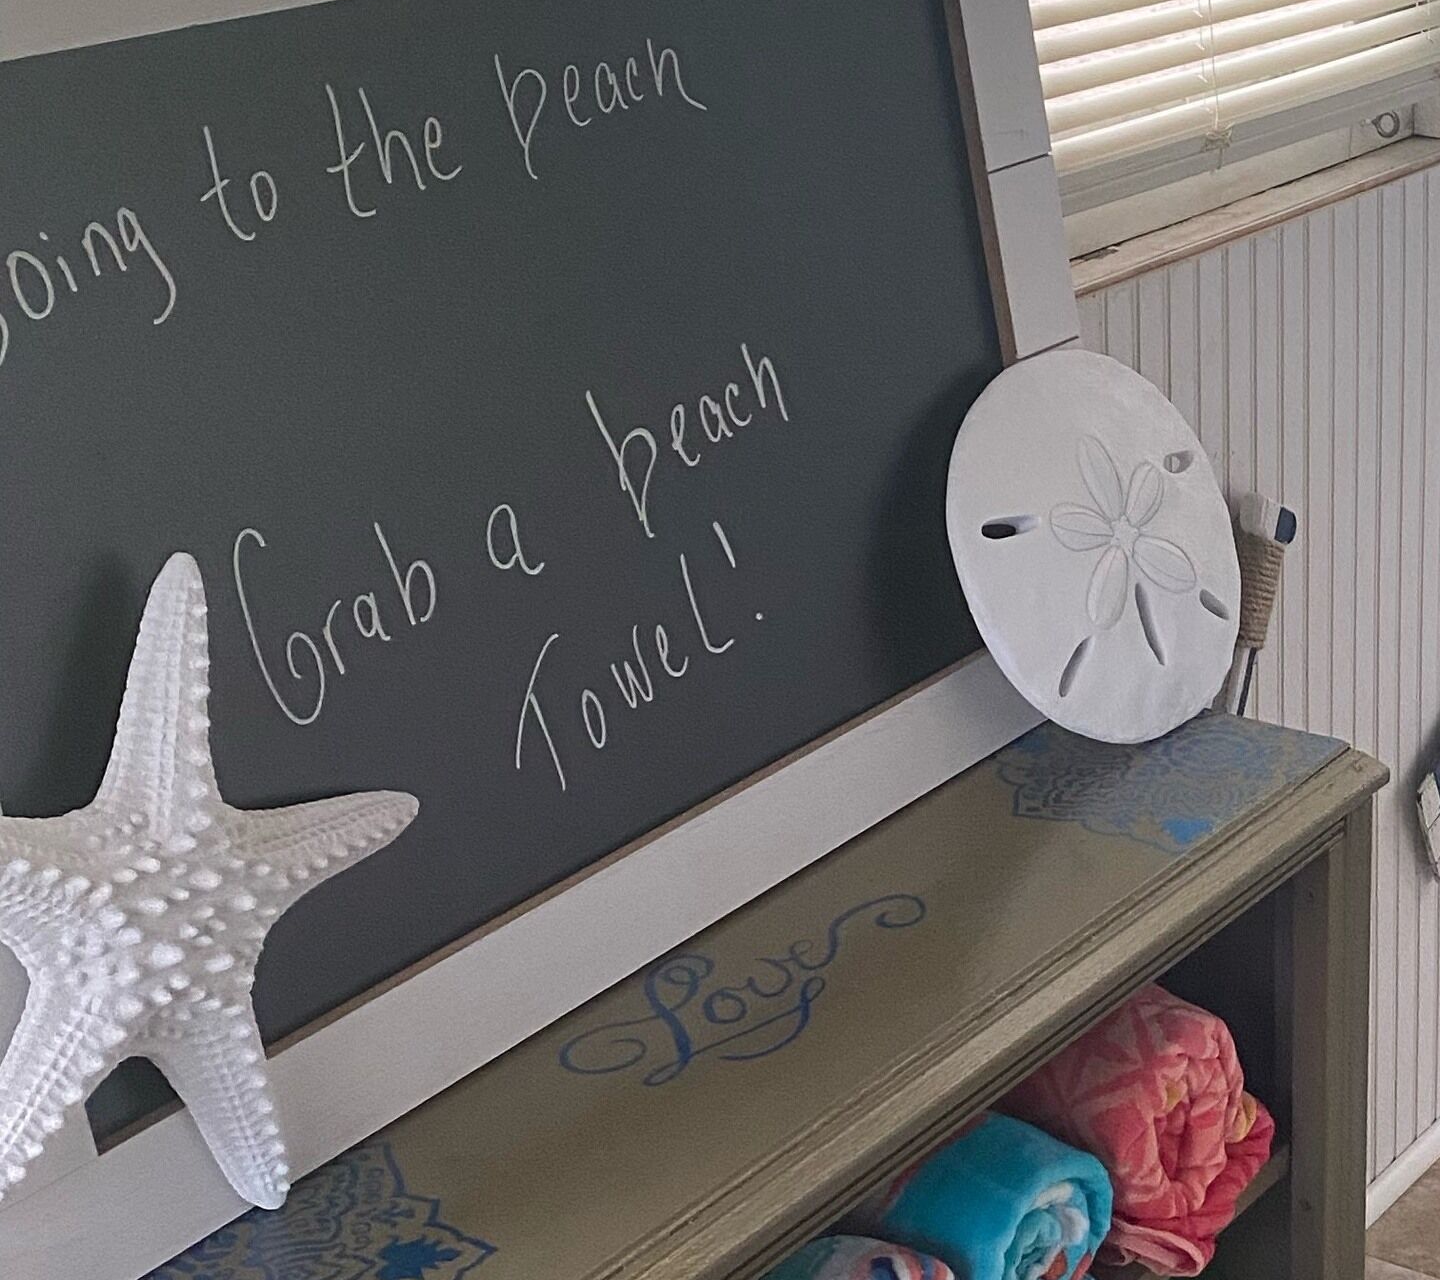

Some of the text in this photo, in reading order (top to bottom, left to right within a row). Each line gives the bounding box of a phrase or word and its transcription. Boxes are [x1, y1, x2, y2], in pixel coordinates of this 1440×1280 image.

[200, 126, 279, 241] to
[326, 84, 463, 219] the
[494, 38, 707, 180] beach
[232, 343, 788, 725] Grab a beach
[559, 893, 926, 1087] Love
